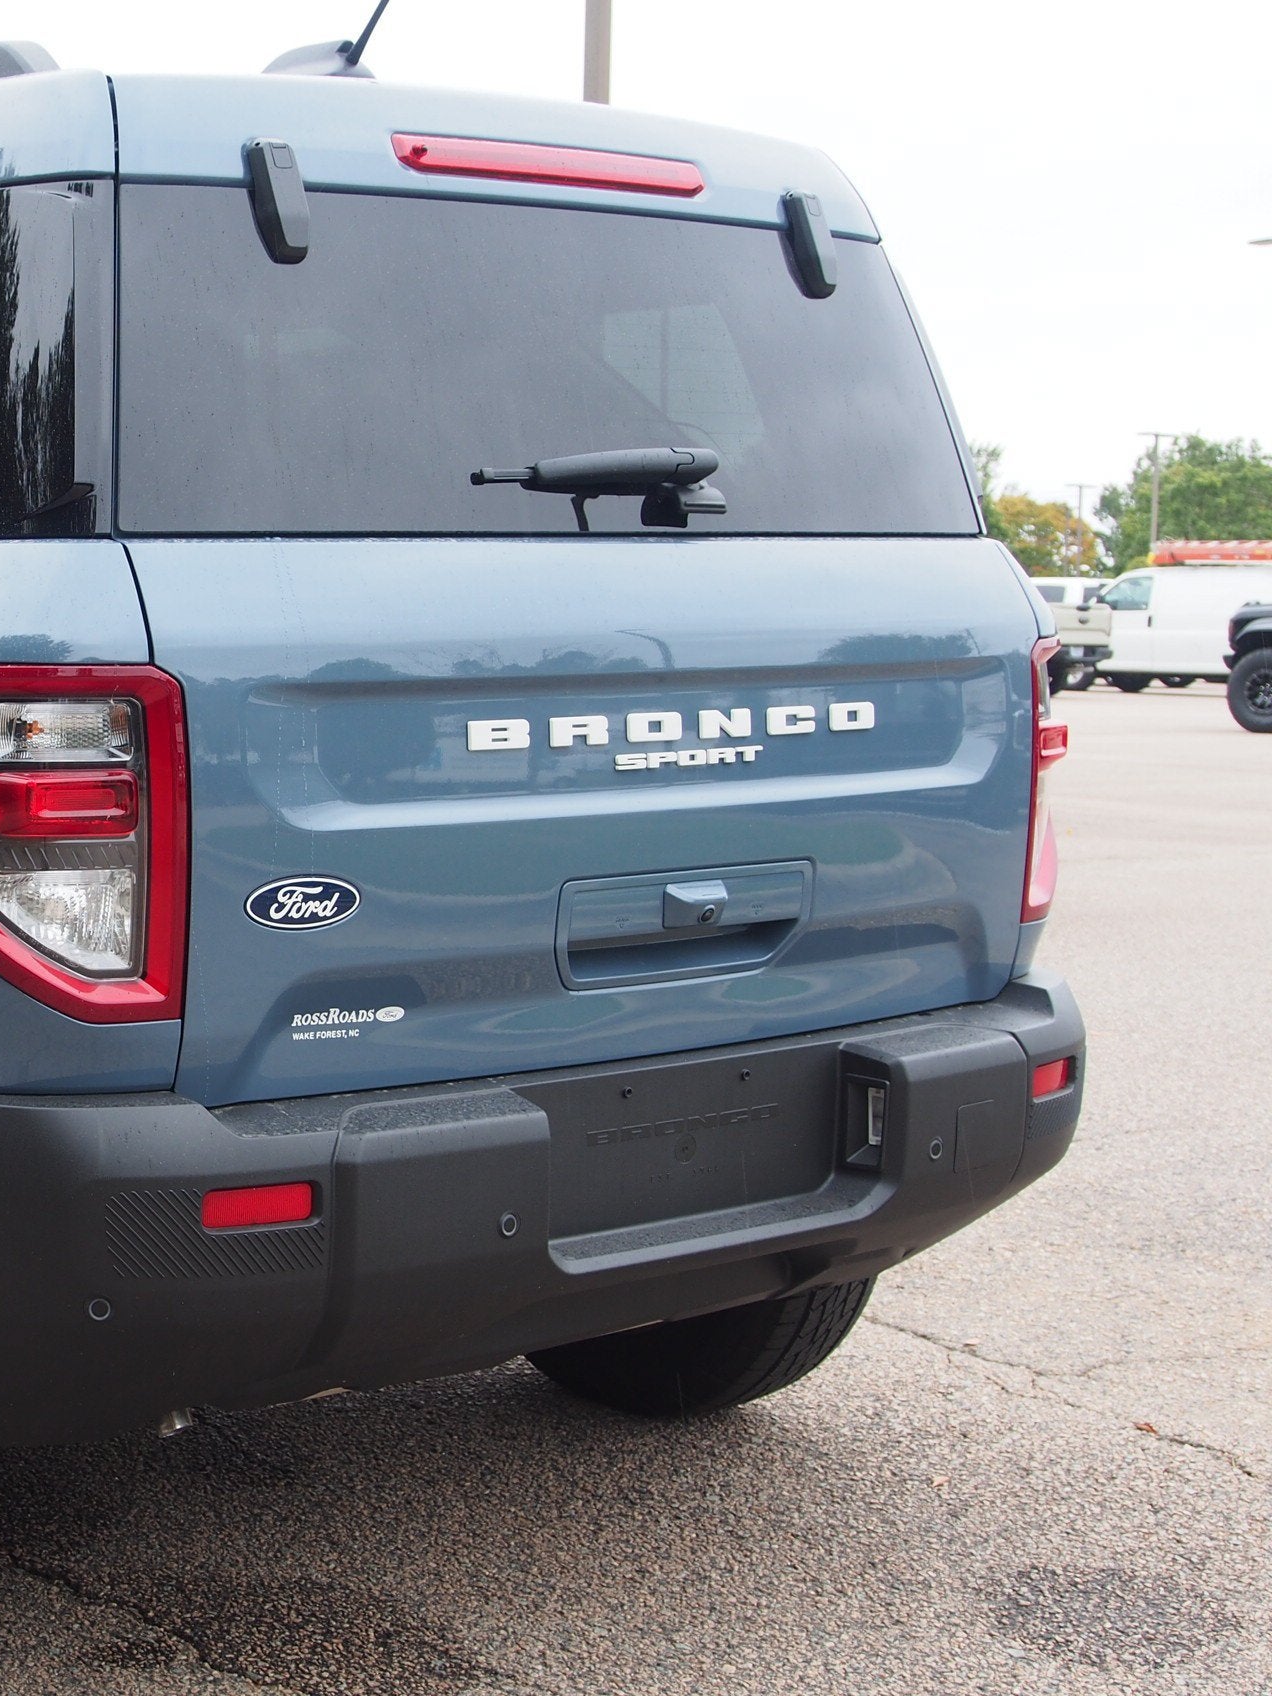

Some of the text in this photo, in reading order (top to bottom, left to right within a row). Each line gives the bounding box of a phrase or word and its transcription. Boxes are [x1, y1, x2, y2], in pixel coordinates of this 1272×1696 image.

[466, 701, 875, 751] BRONCO
[614, 744, 764, 771] SPORT
[269, 885, 340, 920] Ford
[292, 1028, 360, 1040] WAKE FOREST, NC
[586, 1102, 778, 1147] BRONCO
